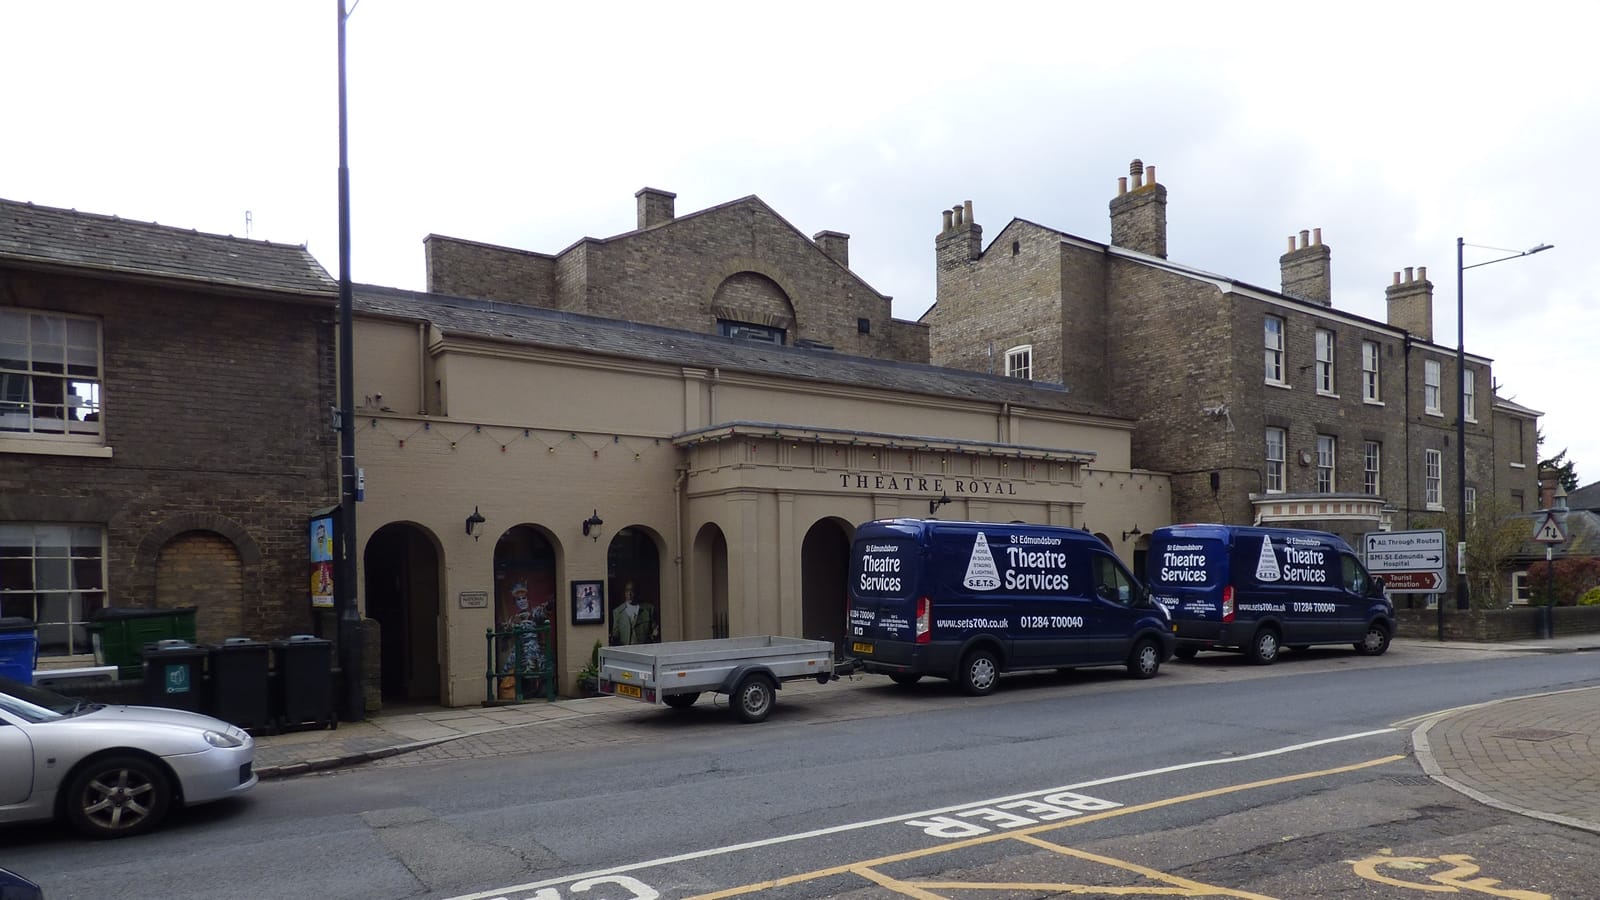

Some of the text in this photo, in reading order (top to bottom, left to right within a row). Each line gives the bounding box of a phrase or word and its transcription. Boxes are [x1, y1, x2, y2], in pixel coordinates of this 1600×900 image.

[840, 474, 1016, 495] THEATRE ROYAL
[1010, 535, 1062, 546] St Edmundsbury
[862, 555, 900, 572] Theatre
[1006, 548, 1066, 568] Theatre
[1164, 552, 1206, 566] Theatre
[1284, 547, 1324, 565] Theatre
[1005, 570, 1069, 590] Services
[1161, 568, 1206, 582] Services
[1283, 565, 1326, 582] Services
[860, 574, 901, 592] Services
[1294, 602, 1312, 612] 01284
[1314, 602, 1336, 612] 700040
[936, 616, 1083, 629] www.sets700.co.uk 01284 700040
[904, 792, 1124, 838] BEER
